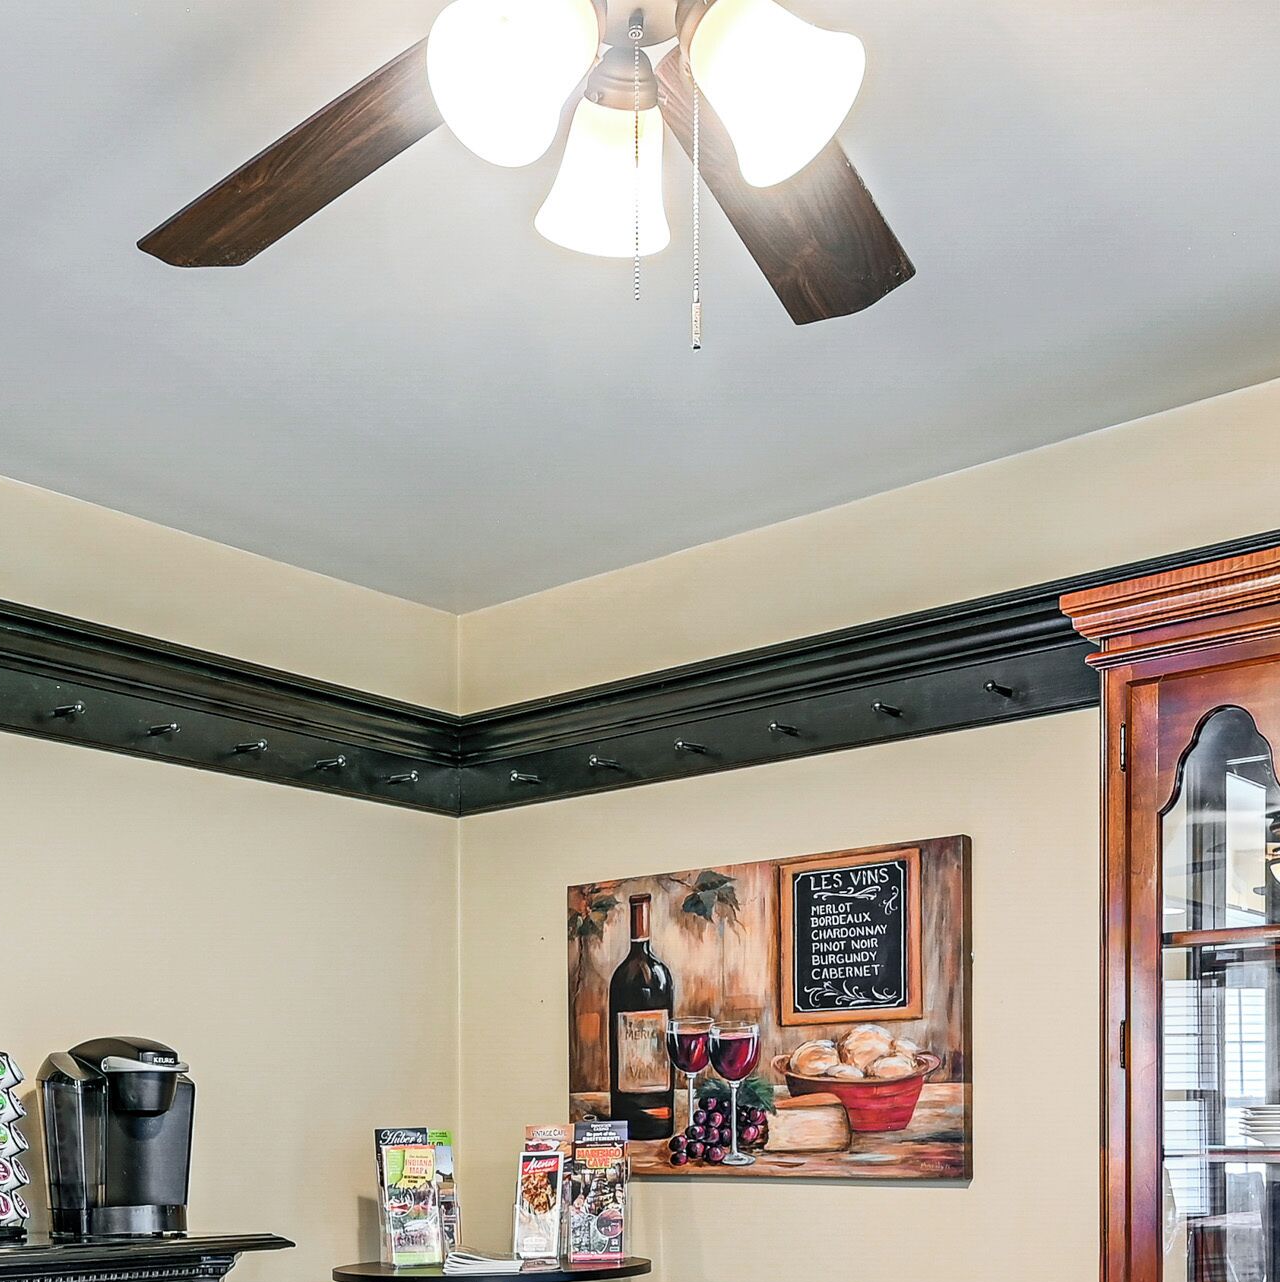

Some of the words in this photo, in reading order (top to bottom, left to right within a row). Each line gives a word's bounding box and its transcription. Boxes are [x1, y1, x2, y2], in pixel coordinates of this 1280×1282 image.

[810, 874, 842, 891] LES
[850, 869, 889, 886] VINS
[811, 902, 853, 916] MERLOT
[811, 912, 872, 927] BORDEAUX
[811, 925, 888, 941] CHARDONNAY
[811, 941, 846, 953] PINOT
[851, 938, 879, 950] NOIR
[811, 951, 878, 966] BURGUNDY
[811, 964, 880, 980] CABERNET
[153, 1056, 175, 1064] KEURIG
[379, 1129, 423, 1145] Huber's
[576, 1148, 622, 1158] MARENGO
[405, 1159, 432, 1167] INDIANA
[524, 1157, 558, 1172] Menu
[587, 1158, 611, 1167] CAVE
